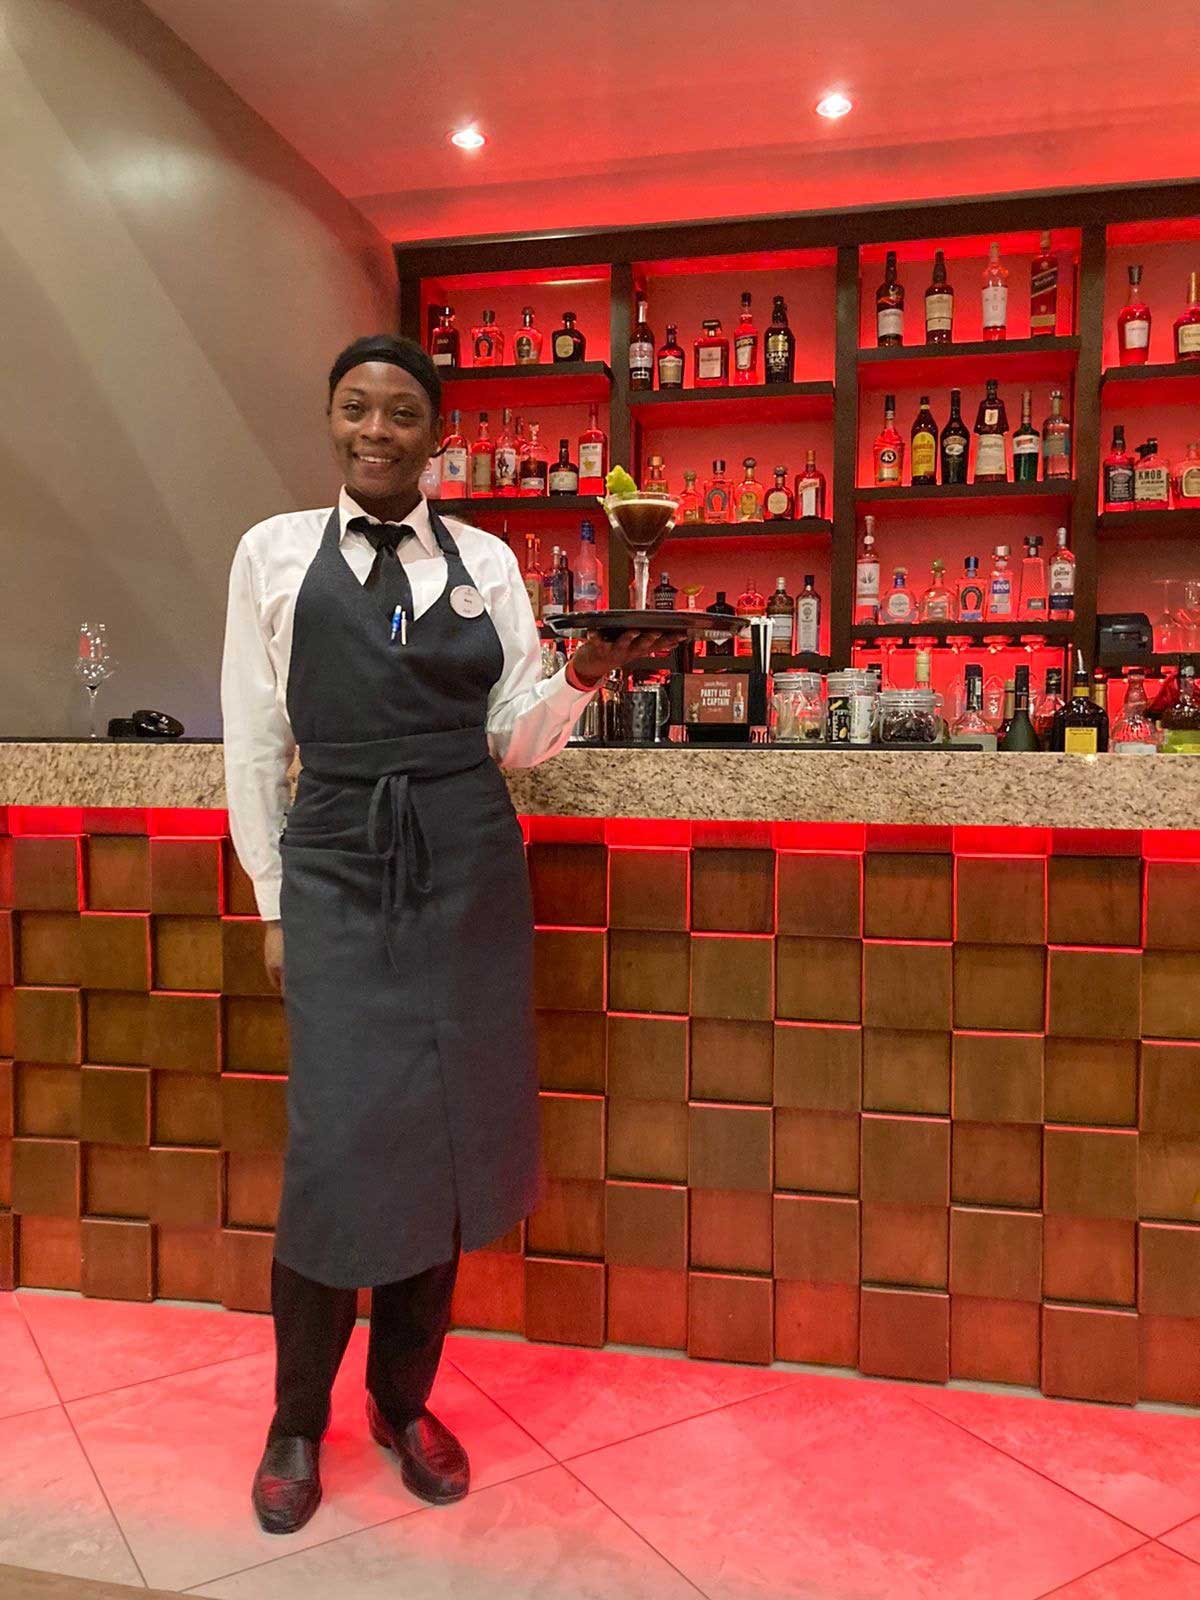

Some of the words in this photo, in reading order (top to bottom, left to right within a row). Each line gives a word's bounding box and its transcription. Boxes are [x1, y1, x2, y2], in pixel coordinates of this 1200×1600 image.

[882, 452, 894, 462] 43
[1138, 469, 1162, 480] KNOB
[700, 688, 718, 698] PARTY
[719, 688, 731, 698] LIKE
[702, 697, 706, 706] A
[707, 697, 730, 706] CAPTAIN
